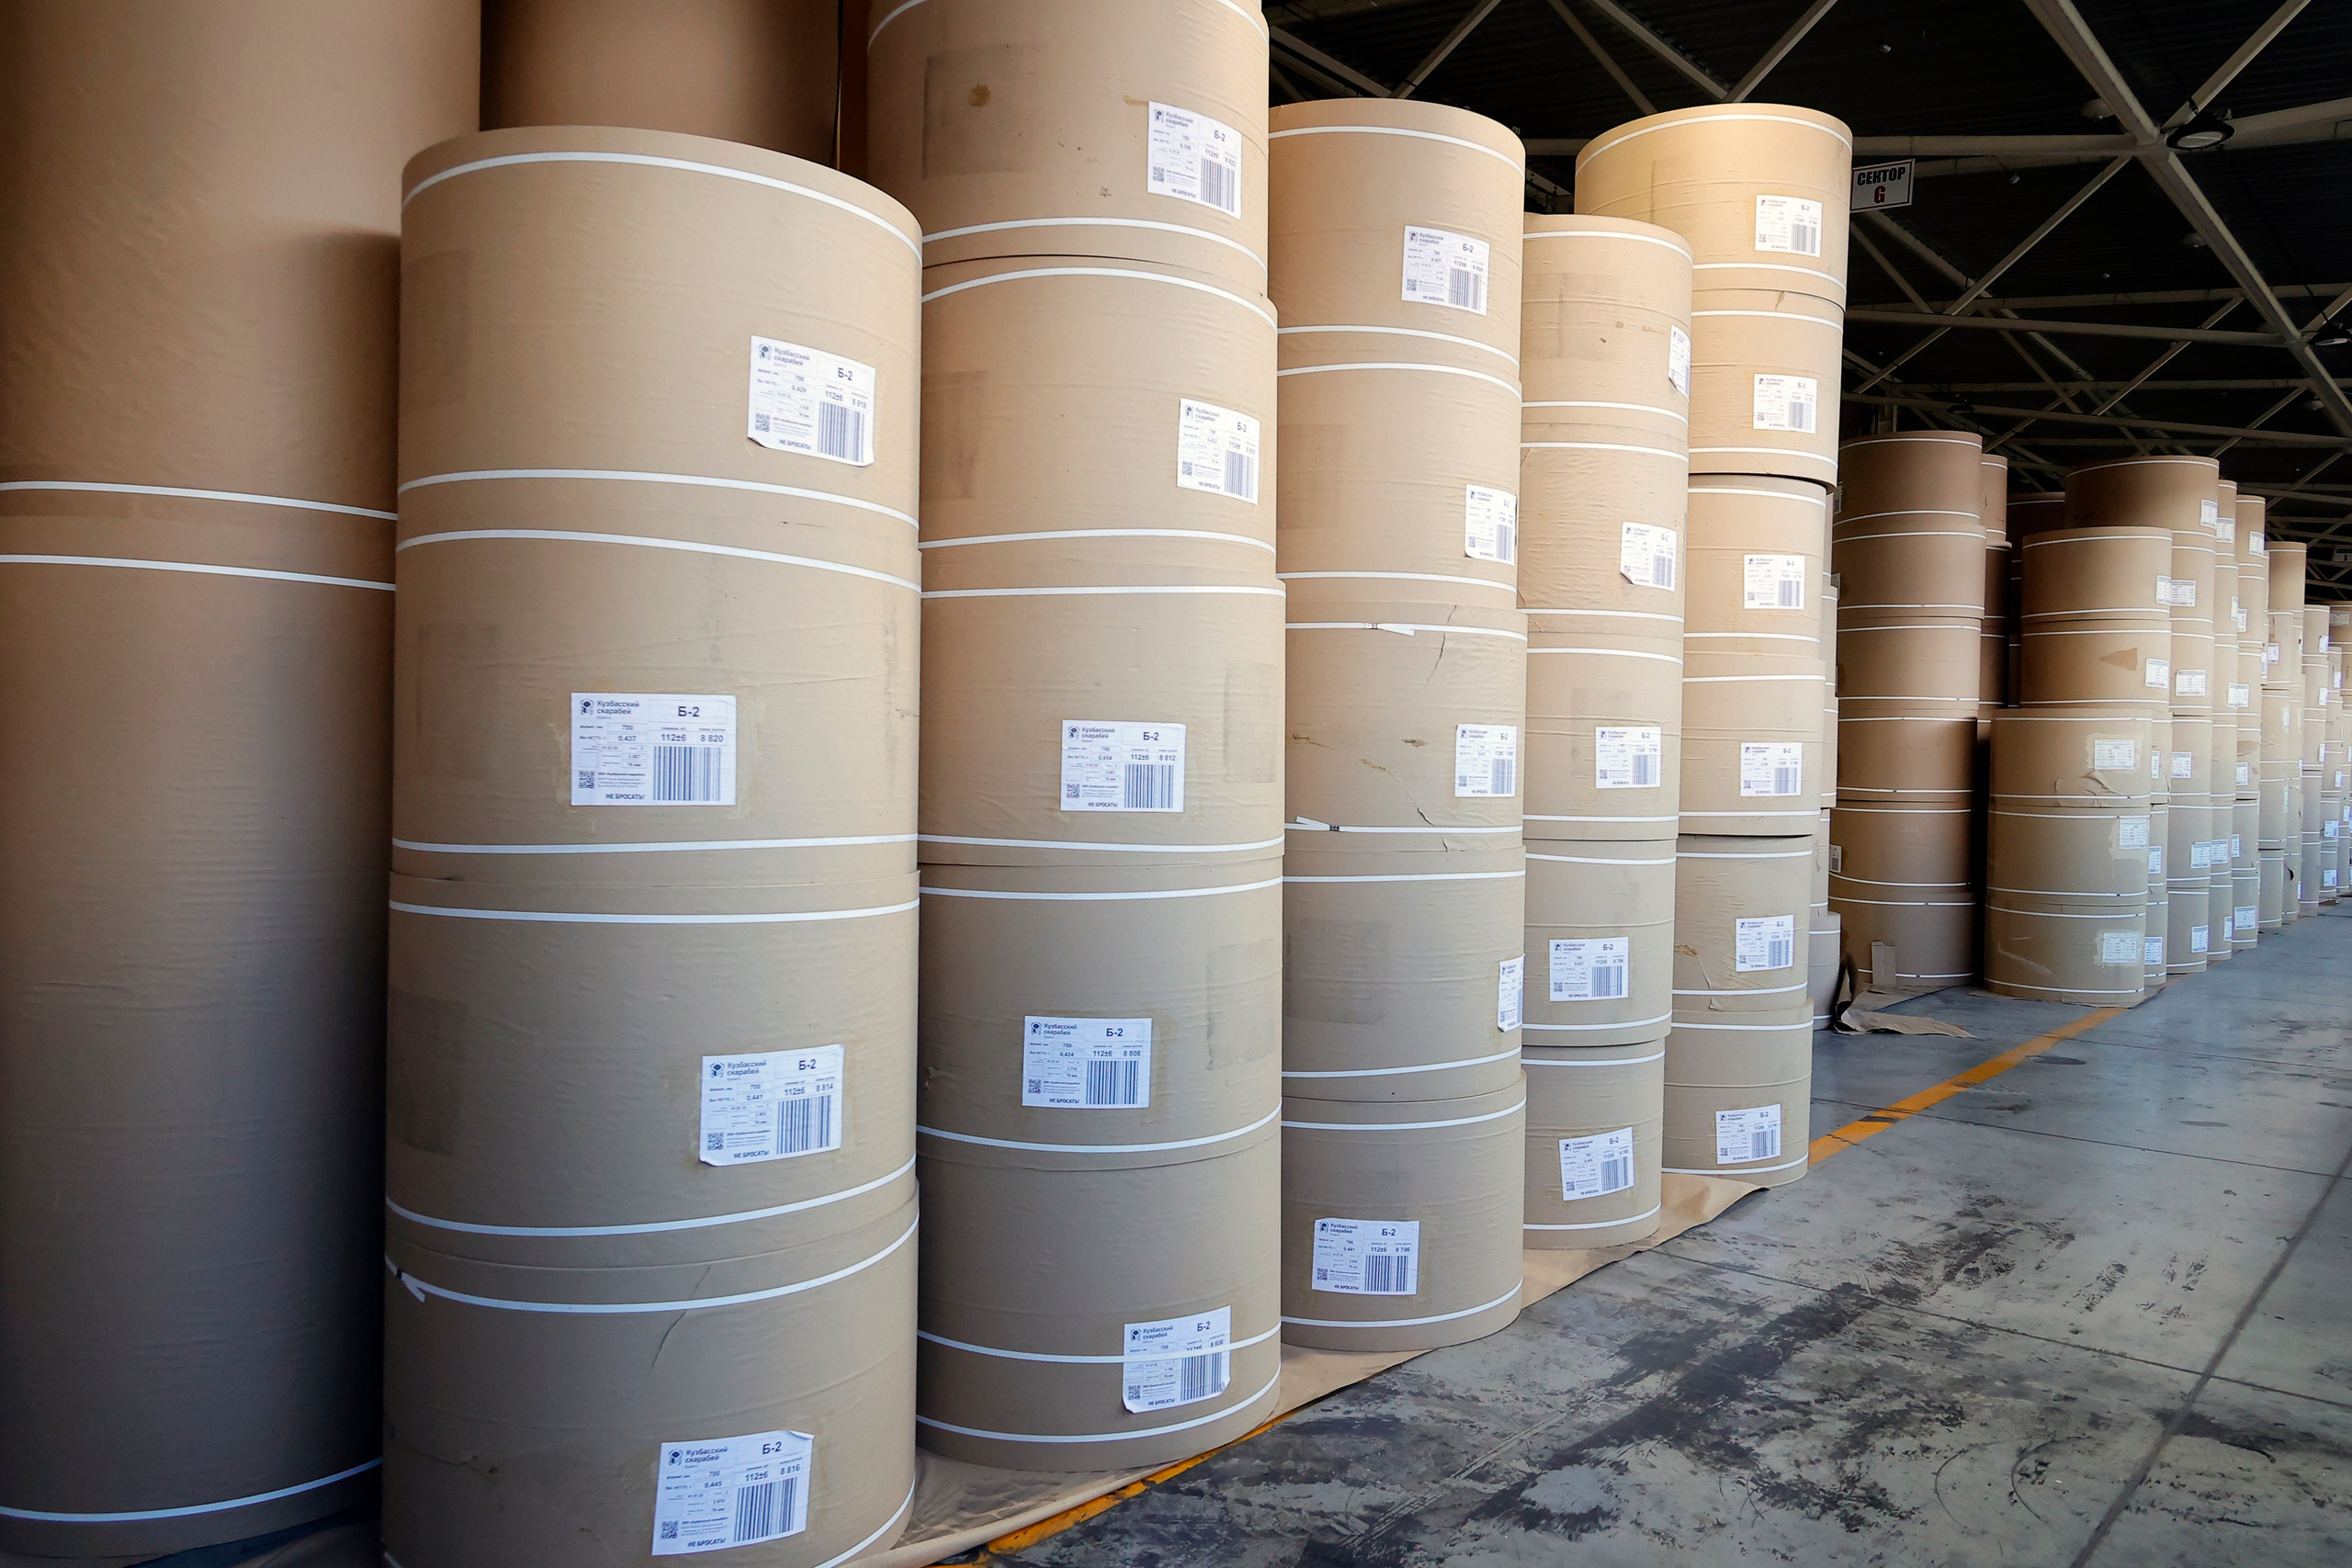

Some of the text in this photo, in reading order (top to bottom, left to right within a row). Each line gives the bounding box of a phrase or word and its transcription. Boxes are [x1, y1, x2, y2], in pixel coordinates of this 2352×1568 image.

[1215, 130, 1225, 142] Б-2
[1857, 167, 1905, 186] СЕКТОР
[1874, 185, 1885, 203] G
[838, 367, 853, 381] Б-2
[825, 390, 843, 402] 112±6
[678, 706, 700, 717] Б-2
[1143, 732, 1159, 741] Б-2
[1106, 1028, 1123, 1037] Б-2
[727, 1060, 767, 1069] Кузбасский
[799, 1059, 816, 1070] Б-2
[727, 1068, 760, 1076] скарабей
[785, 1087, 805, 1095] 112±6
[1143, 1325, 1173, 1334] Кузбасский
[1197, 1321, 1211, 1331] Б-2
[686, 1446, 728, 1457] Кузбасский
[762, 1442, 782, 1455] Б-2
[685, 1454, 719, 1463] скарабей
[780, 1464, 800, 1475] 8 816
[745, 1471, 768, 1481] 112±6
